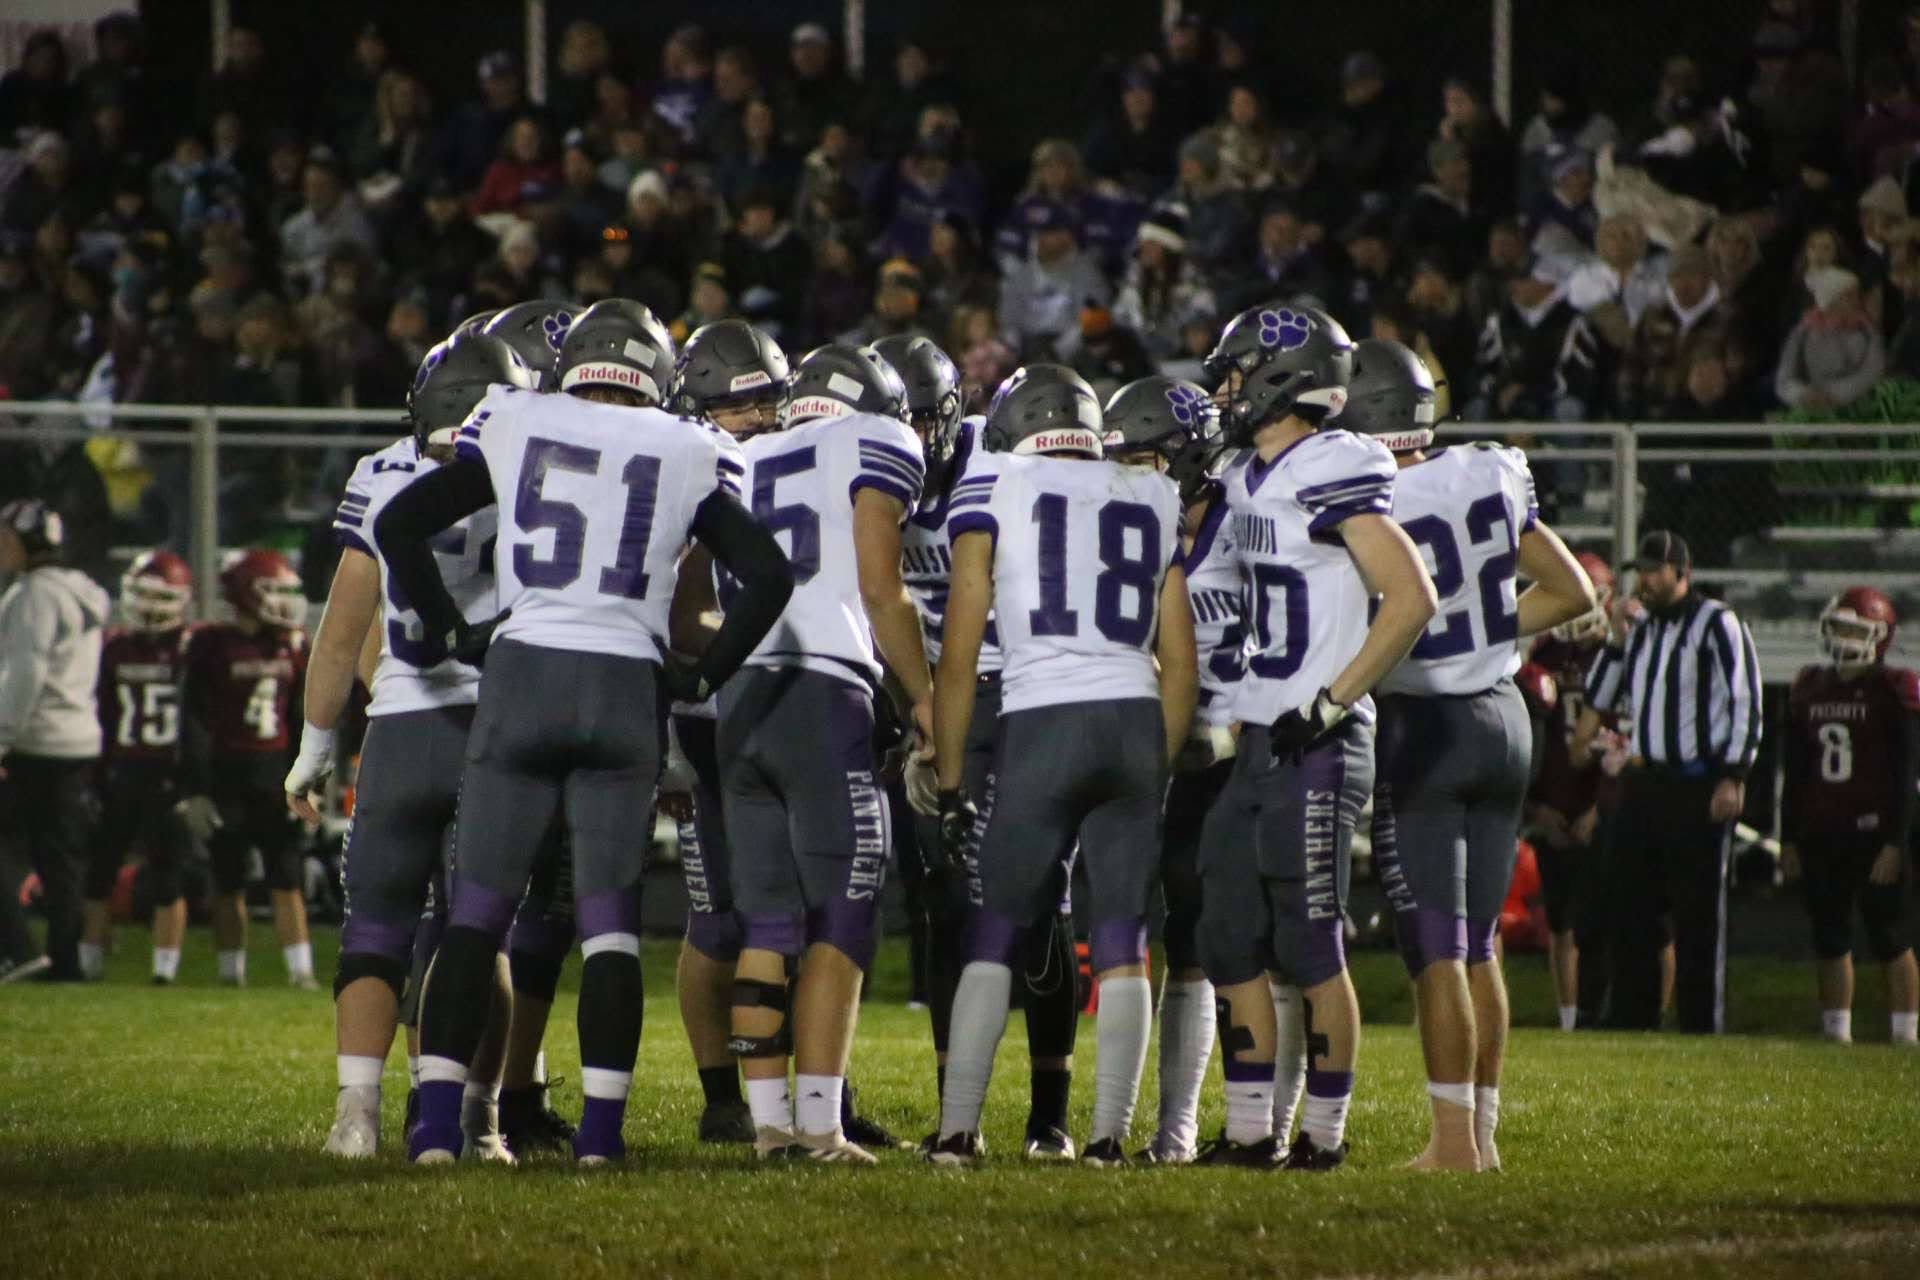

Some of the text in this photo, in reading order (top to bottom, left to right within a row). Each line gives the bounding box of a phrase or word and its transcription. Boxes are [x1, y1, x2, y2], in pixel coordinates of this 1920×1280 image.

[579, 367, 640, 386] Riddell
[1035, 433, 1093, 448] Riddell
[512, 436, 662, 600] 51
[1030, 492, 1161, 648] 18
[1398, 490, 1519, 660] 22
[116, 682, 180, 748] 15
[243, 677, 280, 741] 4
[1818, 722, 1853, 784] 8
[847, 770, 883, 901] PANTHERS
[1304, 789, 1336, 920] PANTHERS
